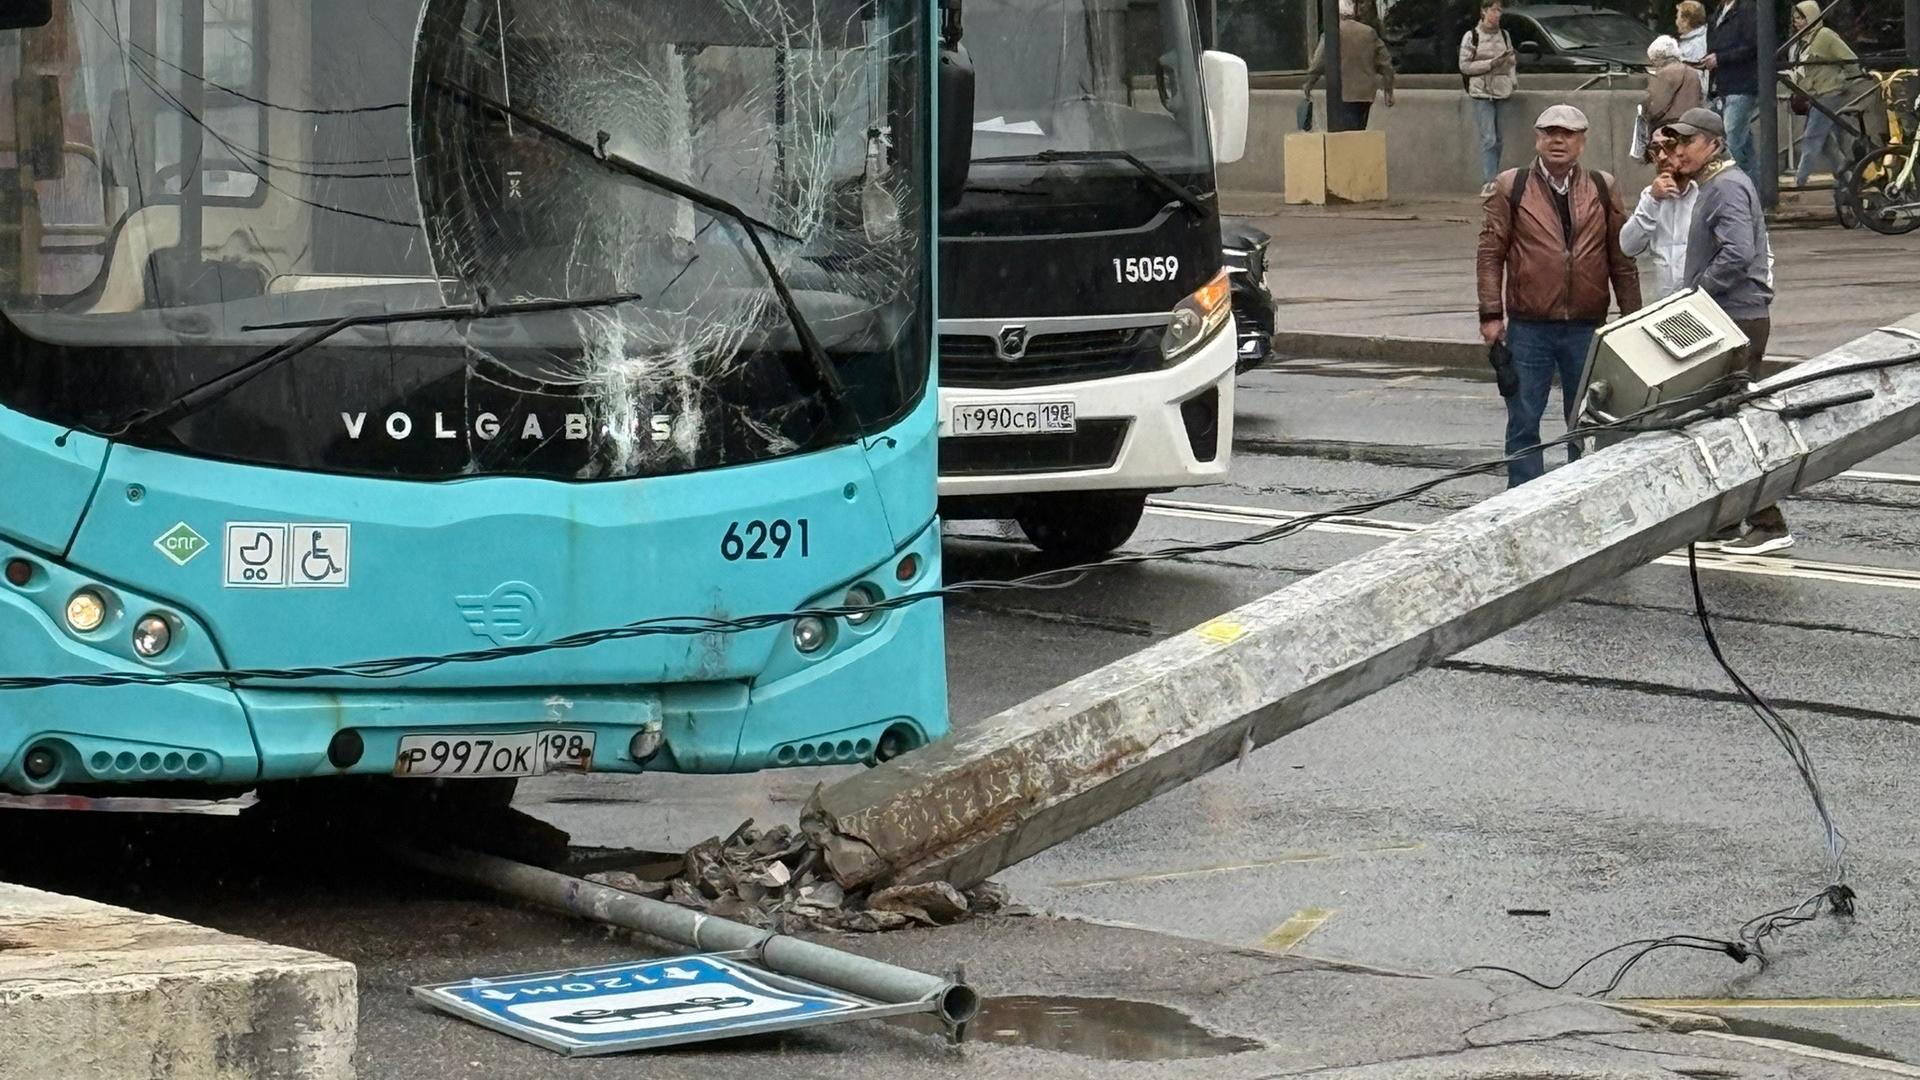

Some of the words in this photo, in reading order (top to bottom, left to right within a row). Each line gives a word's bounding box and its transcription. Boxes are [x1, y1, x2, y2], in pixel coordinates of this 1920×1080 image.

[1112, 255, 1179, 283] 15059
[720, 518, 809, 562] 6291
[538, 733, 584, 762] 198
